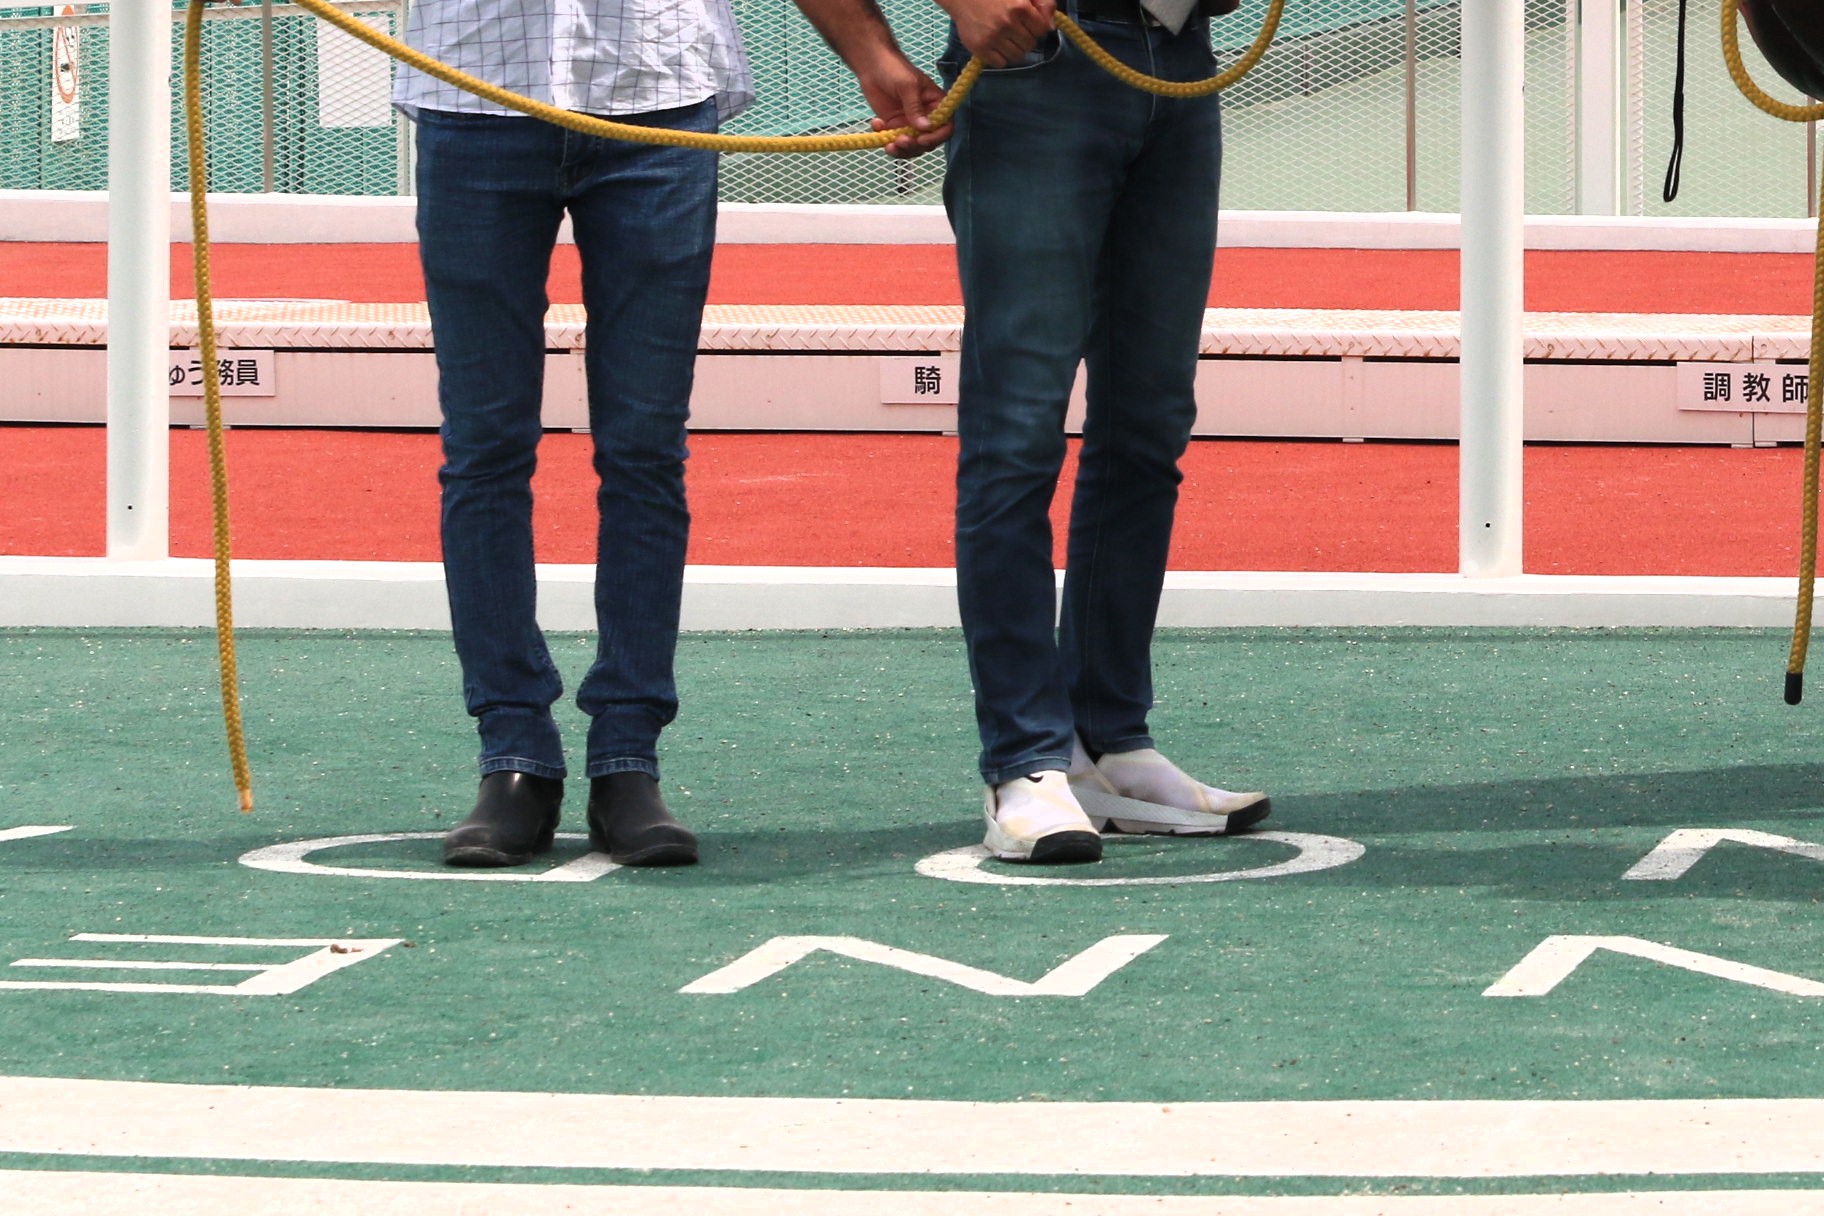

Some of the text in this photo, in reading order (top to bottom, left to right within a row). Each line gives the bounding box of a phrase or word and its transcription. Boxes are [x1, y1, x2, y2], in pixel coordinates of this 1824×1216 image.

[914, 366, 942, 395] 騎
[1703, 372, 1809, 404] 調教師
